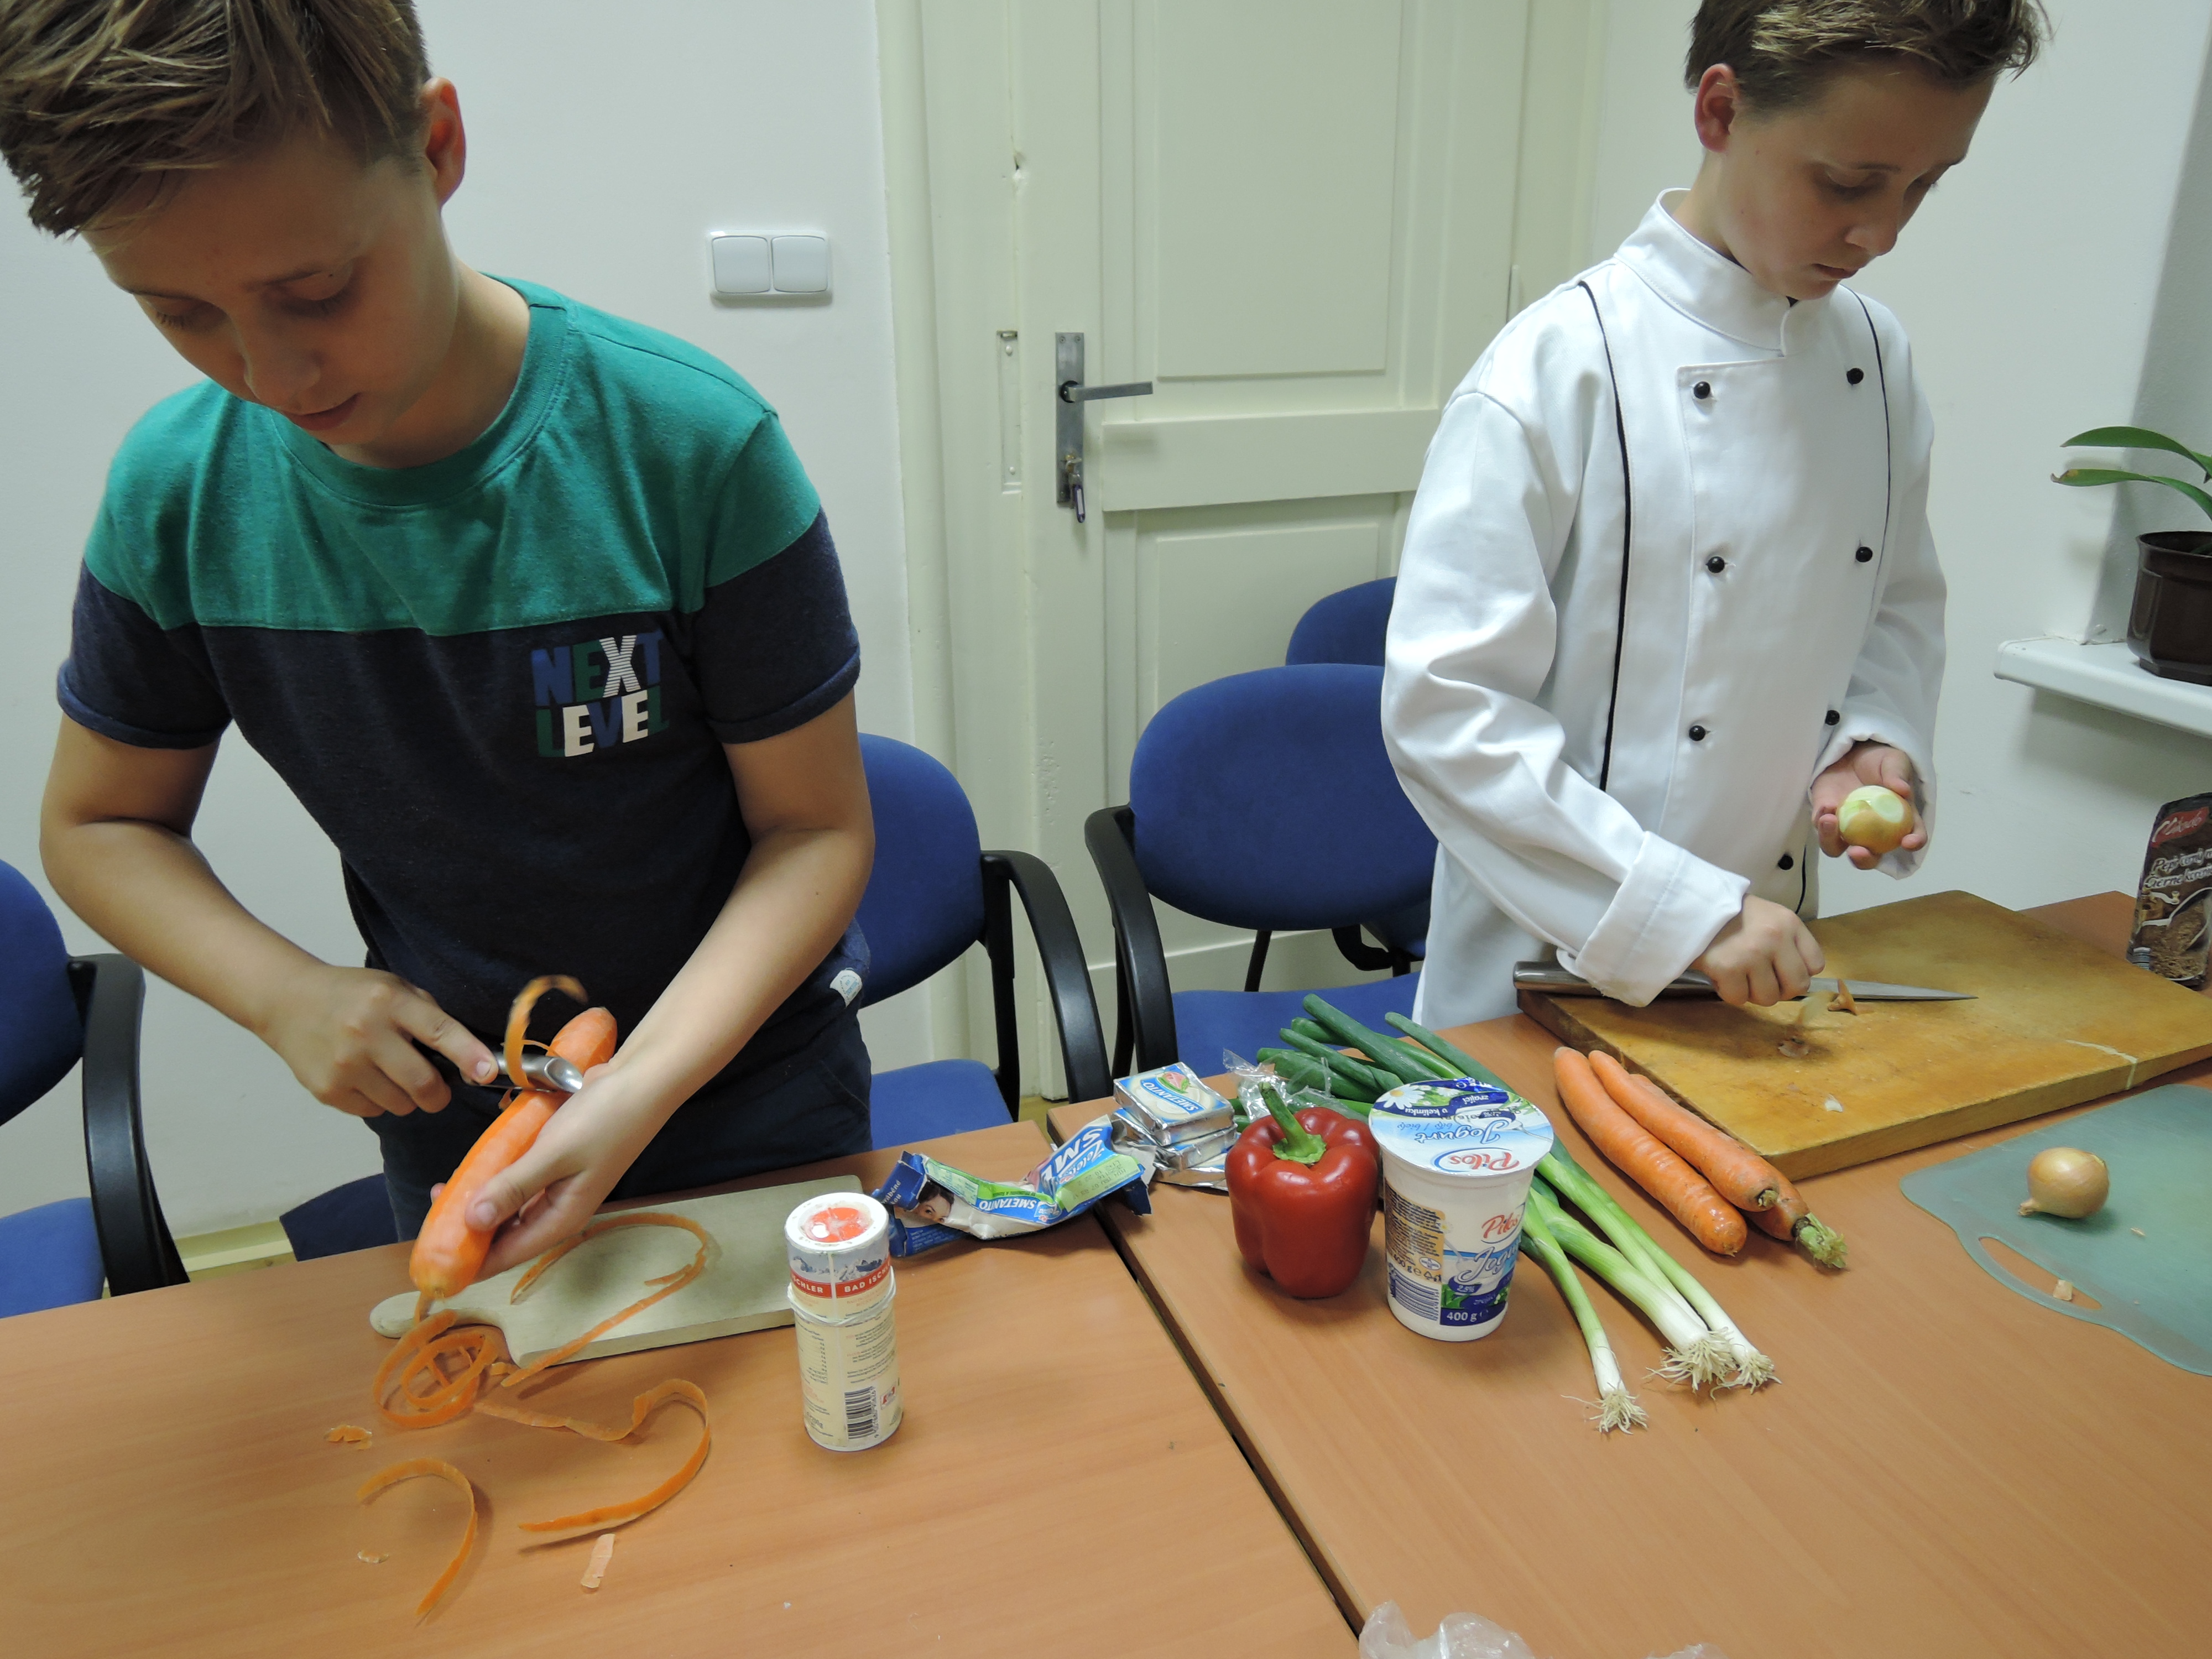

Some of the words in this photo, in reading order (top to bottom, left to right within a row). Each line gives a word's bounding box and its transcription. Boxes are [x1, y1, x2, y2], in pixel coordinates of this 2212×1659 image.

[531, 628, 664, 706] NEXT
[536, 685, 669, 757] LEVEL
[1144, 1081, 1198, 1112] SMETANITO
[1414, 1119, 1510, 1145] Jogurt
[1449, 1151, 1520, 1172] Pilos
[979, 1199, 1037, 1212] SMETANITO
[791, 1274, 824, 1293] SCHLER
[844, 1281, 865, 1293] BAD
[1446, 1312, 1469, 1321] 400
[1470, 1313, 1478, 1323] g
